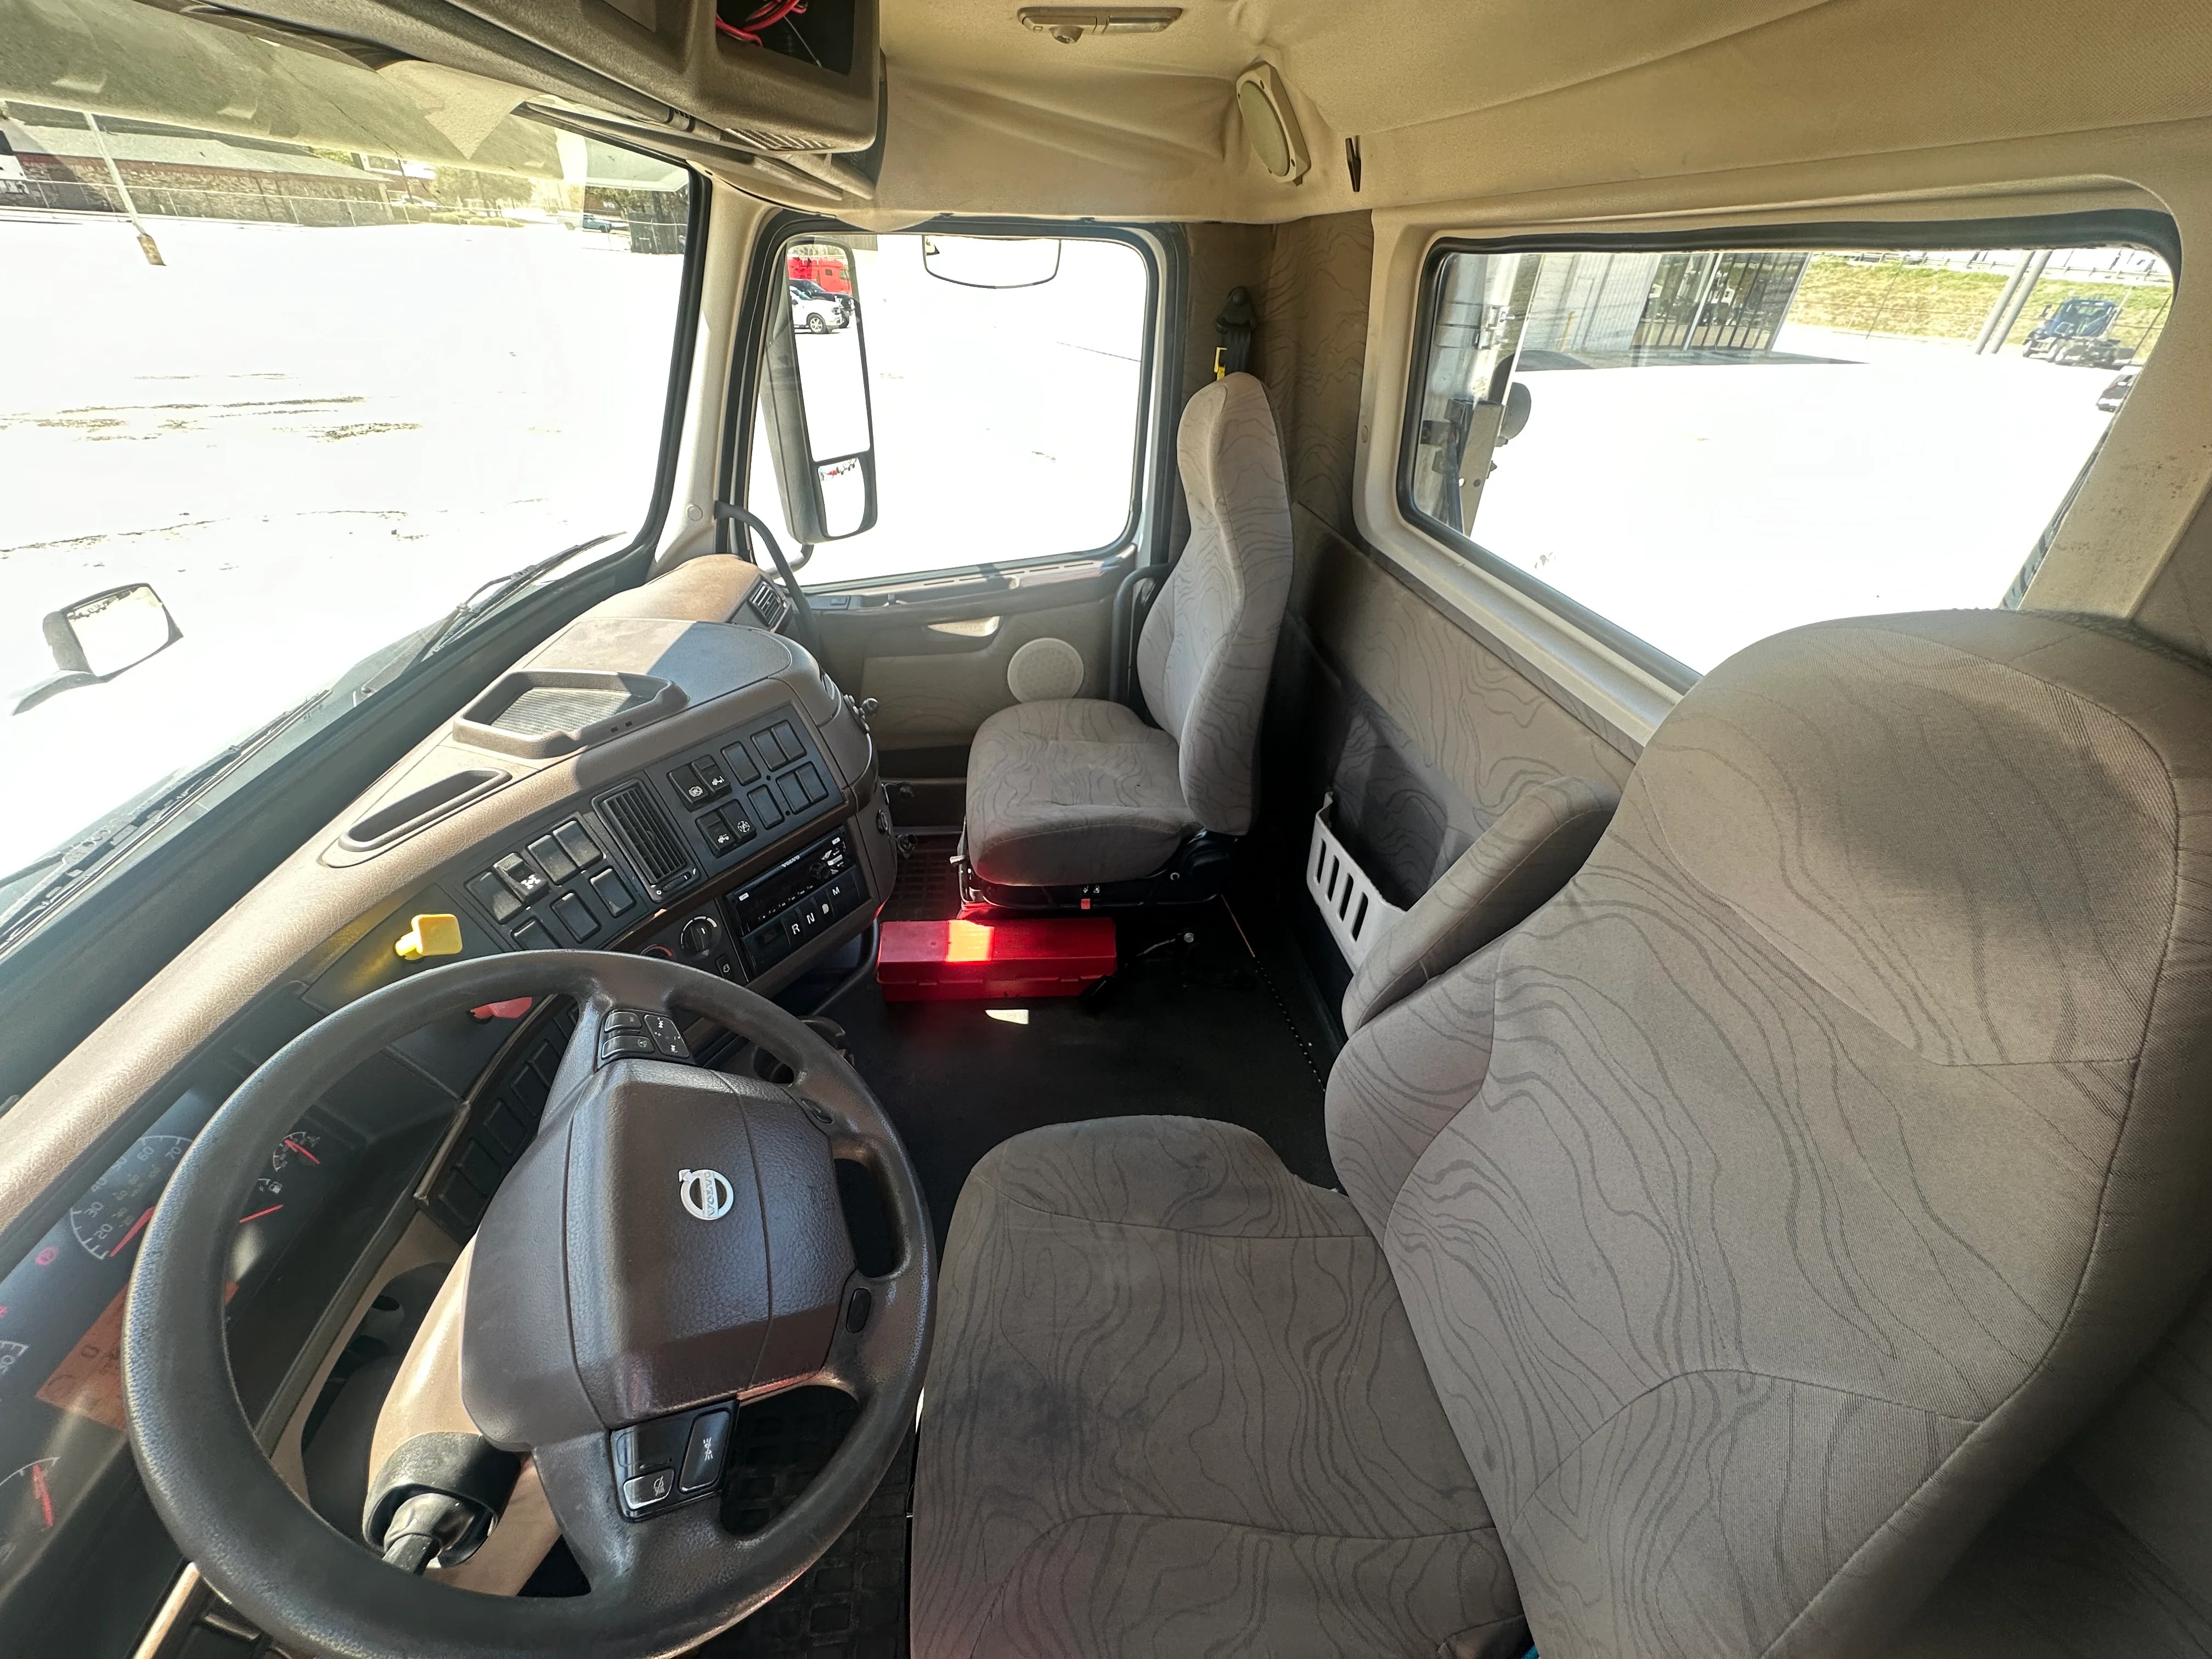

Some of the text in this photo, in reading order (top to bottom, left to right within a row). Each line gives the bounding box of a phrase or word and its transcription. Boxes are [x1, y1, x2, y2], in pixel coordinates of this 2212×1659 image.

[781, 855, 800, 867] VOLVO
[791, 923, 800, 935] R
[806, 912, 815, 924] N
[832, 887, 840, 896] M
[138, 1146, 154, 1161] 60
[165, 1146, 182, 1160] 70
[704, 1171, 714, 1217] VOLVO
[84, 1201, 104, 1217] 30
[94, 1223, 113, 1240] 20
